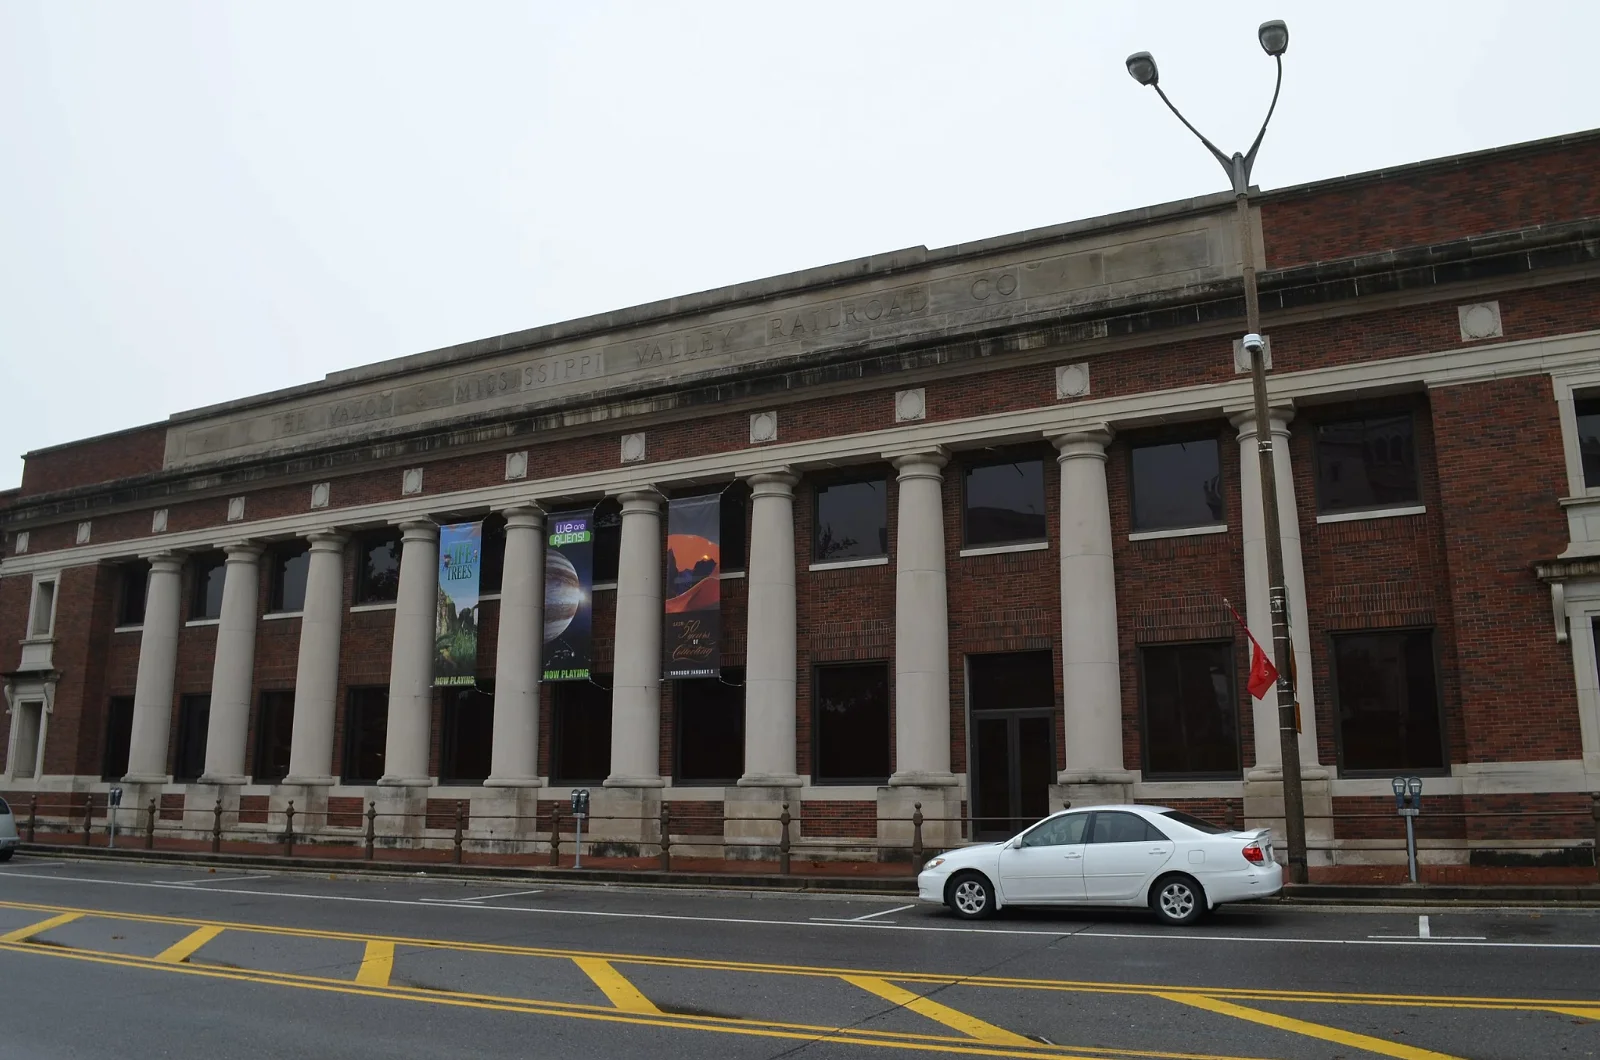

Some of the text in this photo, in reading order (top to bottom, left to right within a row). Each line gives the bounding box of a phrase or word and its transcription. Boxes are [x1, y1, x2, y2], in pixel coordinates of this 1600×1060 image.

[271, 409, 306, 435] THE
[456, 353, 602, 401] MISSISSIPPI
[634, 326, 735, 366] VALLEY
[769, 289, 929, 340] RAILROAD
[970, 273, 1019, 300] CO
[447, 564, 473, 581] TREES
[677, 620, 700, 639] 50
[435, 675, 475, 686] NOW PLAYING
[544, 668, 589, 679] NOW PLAYING
